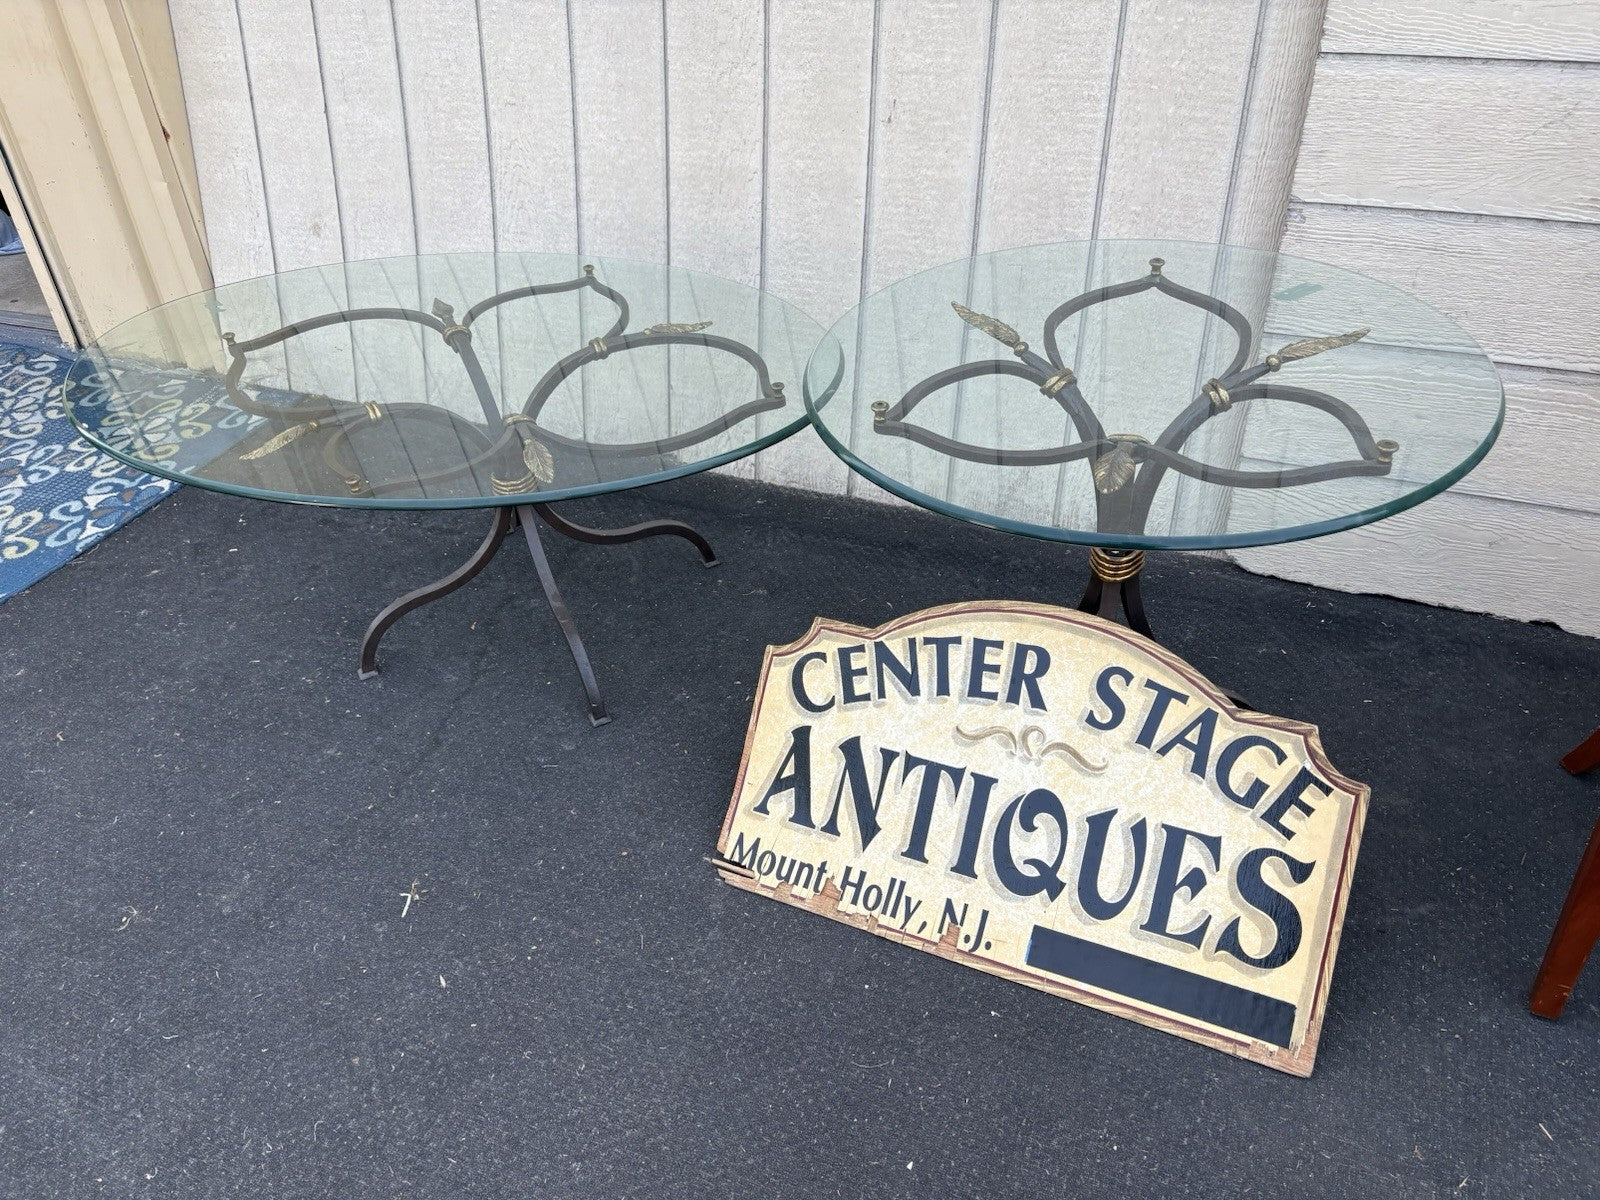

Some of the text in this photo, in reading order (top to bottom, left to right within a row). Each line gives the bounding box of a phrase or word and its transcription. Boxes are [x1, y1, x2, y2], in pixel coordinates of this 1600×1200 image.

[791, 636, 1334, 840] CENTER STAGE
[730, 832, 992, 953] Mount Holly, N.J.
[752, 725, 1316, 970] ANTIQUES
